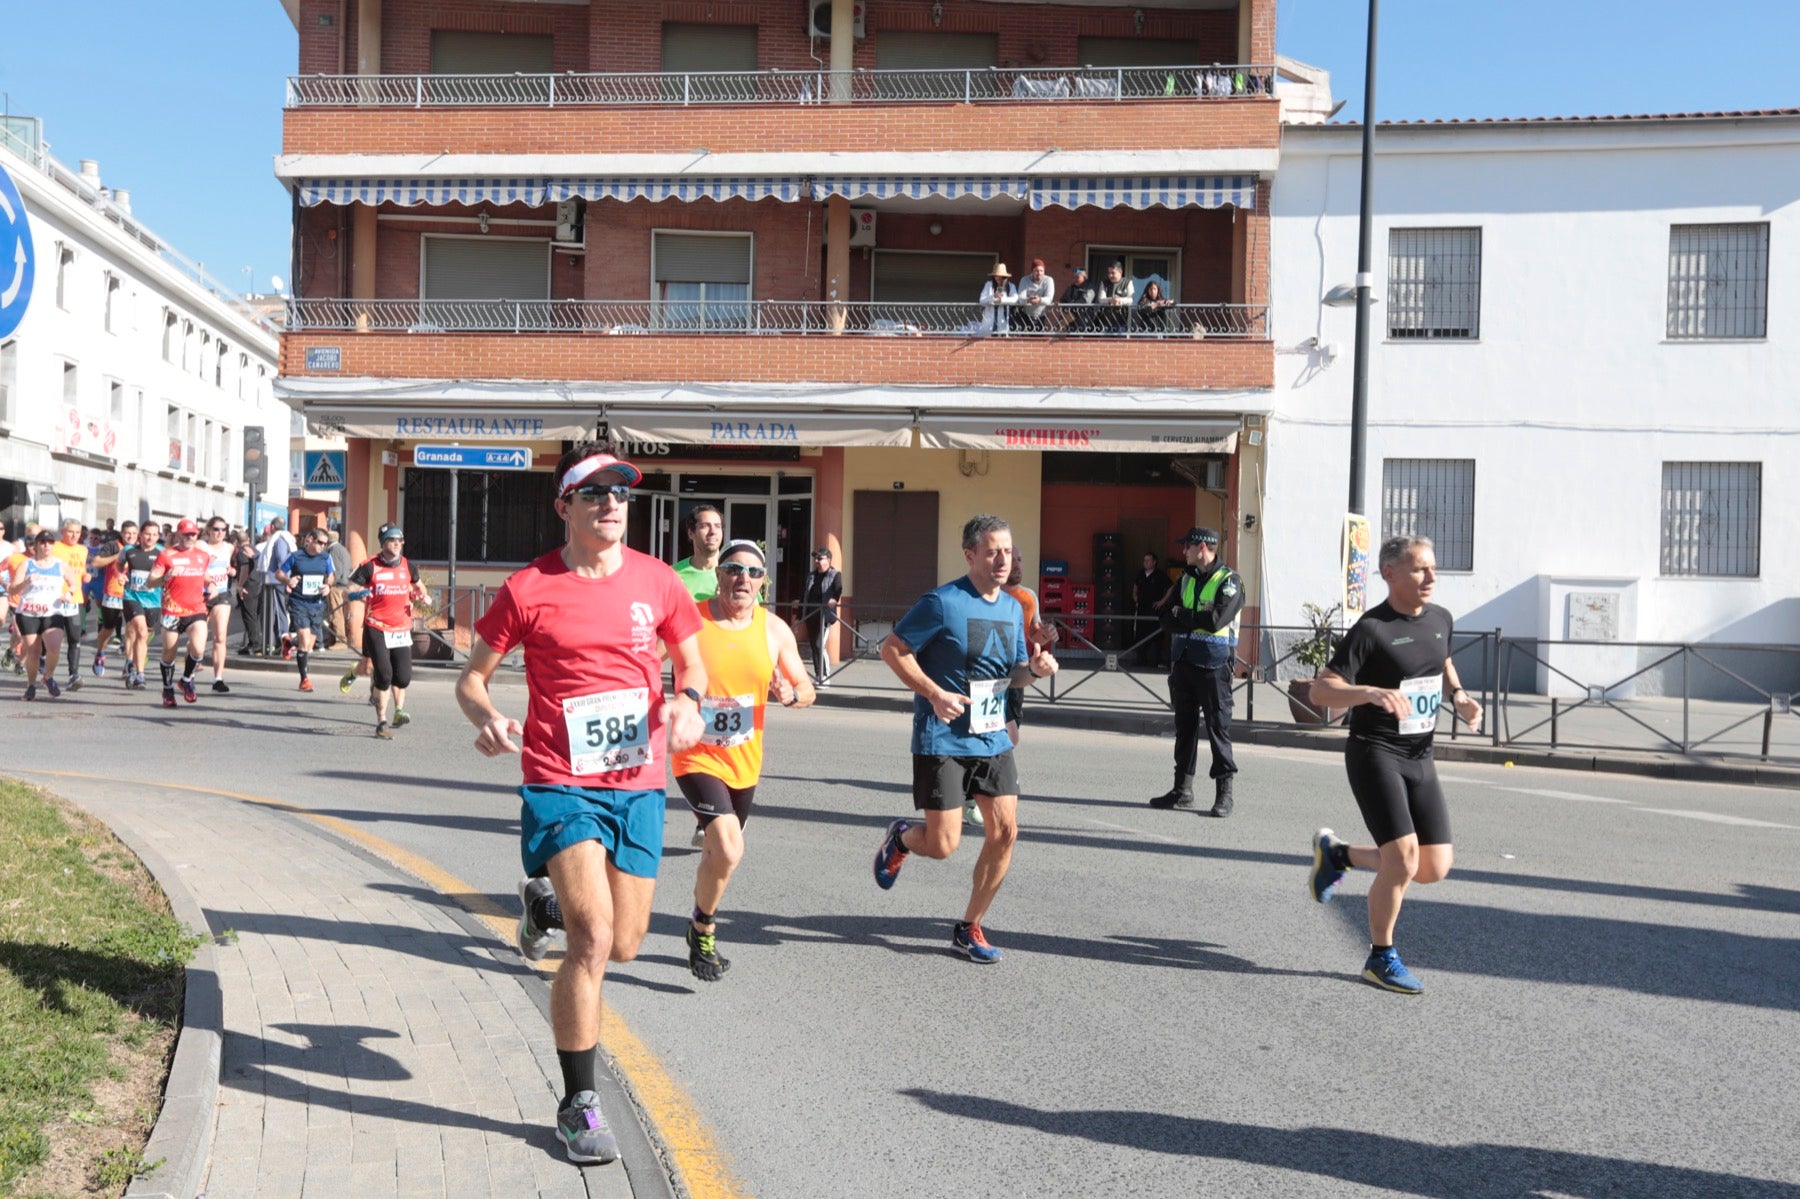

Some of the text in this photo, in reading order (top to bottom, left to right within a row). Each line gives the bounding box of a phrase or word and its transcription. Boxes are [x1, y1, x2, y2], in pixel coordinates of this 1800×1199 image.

[397, 416, 544, 436] RESTAURANTE
[710, 422, 798, 440] PARADA
[417, 451, 463, 462] Granada
[586, 714, 638, 747] 585
[714, 712, 741, 732] 83
